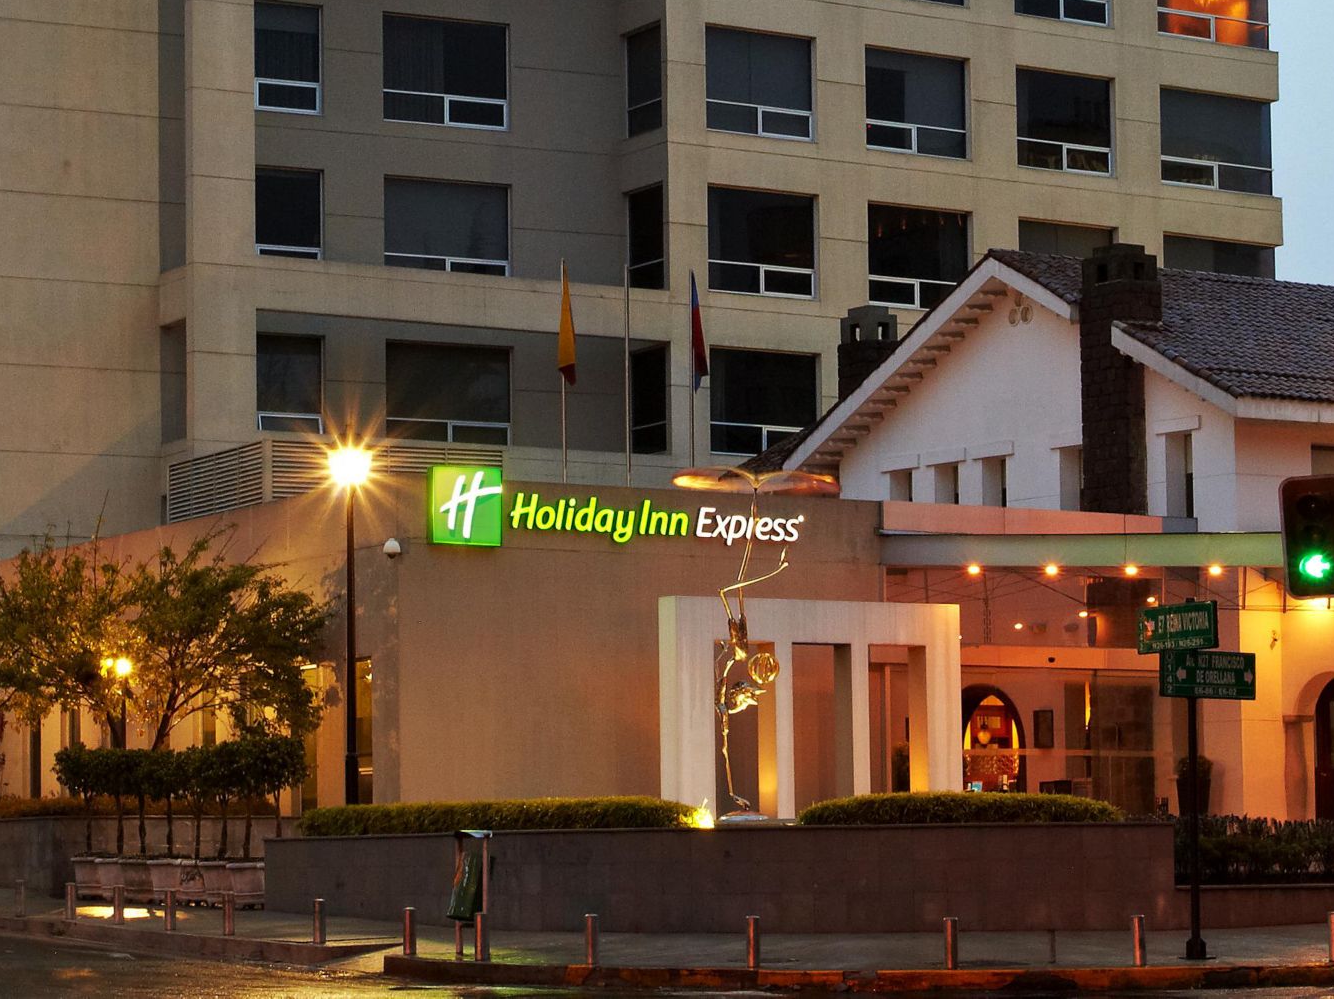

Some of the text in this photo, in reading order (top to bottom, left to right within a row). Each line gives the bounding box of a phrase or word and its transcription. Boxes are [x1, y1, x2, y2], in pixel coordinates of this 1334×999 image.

[511, 492, 800, 545] Holiday Inn Express
[1182, 610, 1209, 631] VICTORIA
[1211, 655, 1245, 669] FRANCISCO
[1196, 670, 1236, 684] DE ORELLANA
